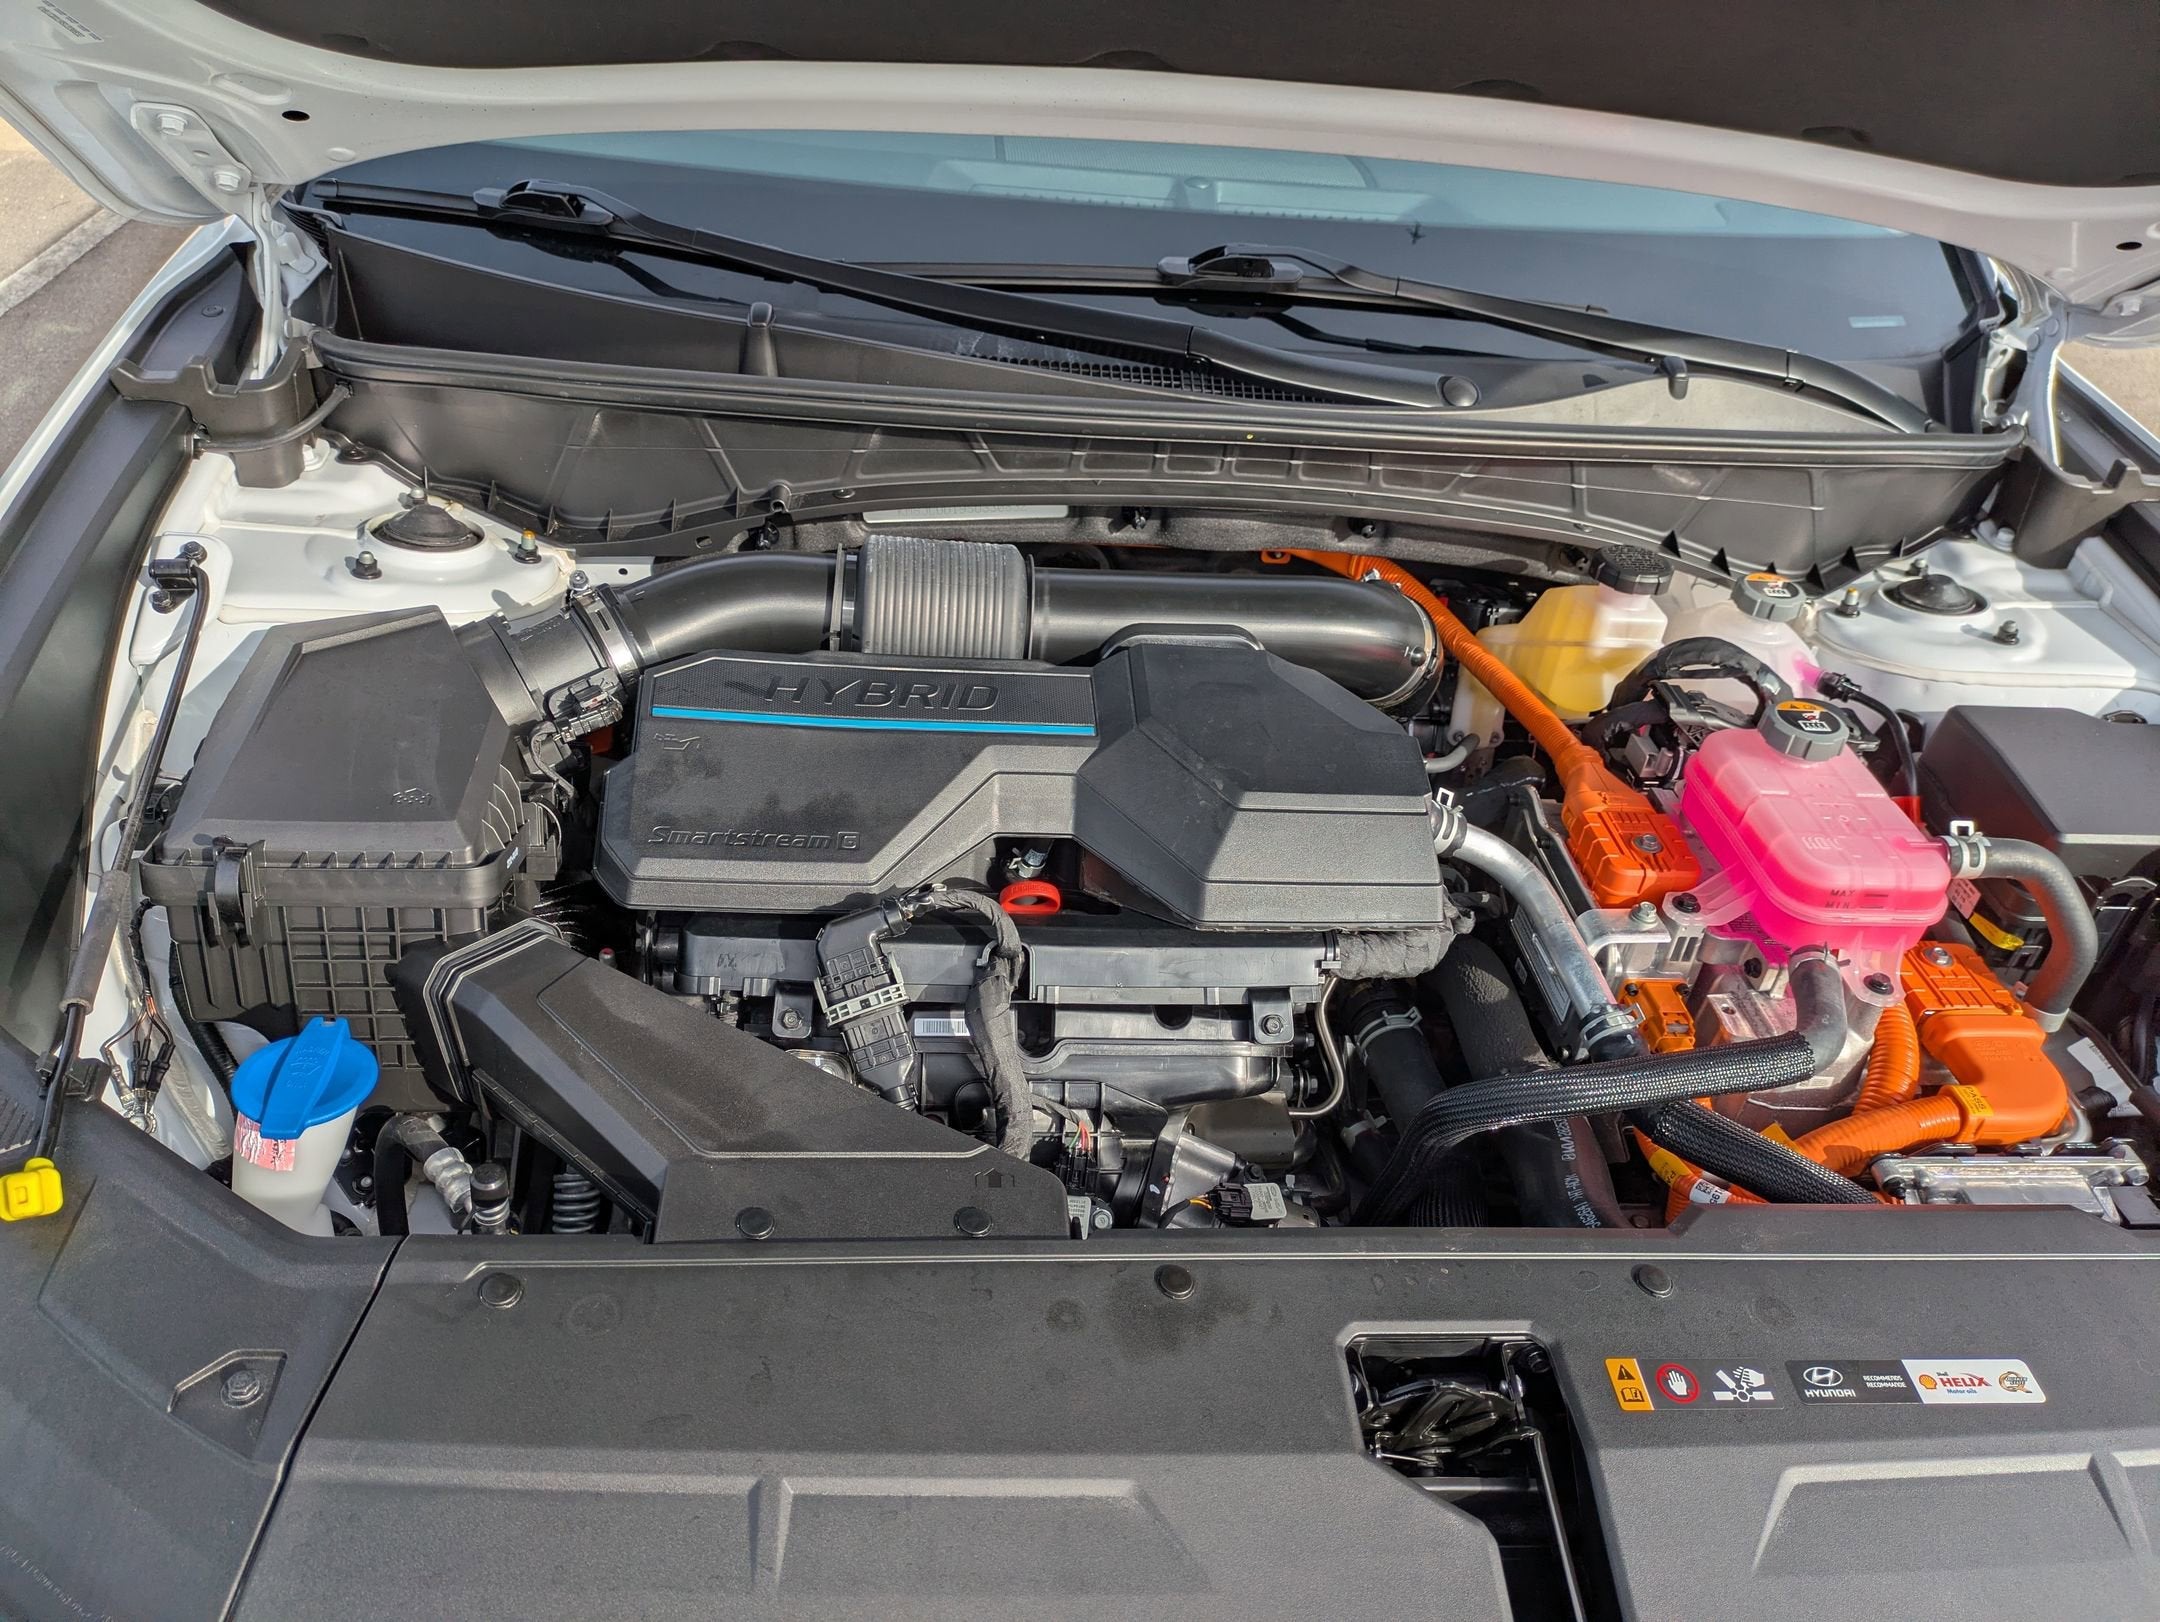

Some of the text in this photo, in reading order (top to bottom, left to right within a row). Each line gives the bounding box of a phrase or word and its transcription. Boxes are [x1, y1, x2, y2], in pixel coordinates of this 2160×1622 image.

[764, 675, 1001, 711] HYBRID
[648, 826, 860, 850] Smartstream G
[1831, 889, 1856, 897] MAX
[1824, 901, 1850, 909] MIN
[1939, 1376, 1992, 1388] HELIX
[1805, 1388, 1856, 1398] HYUNDAI
